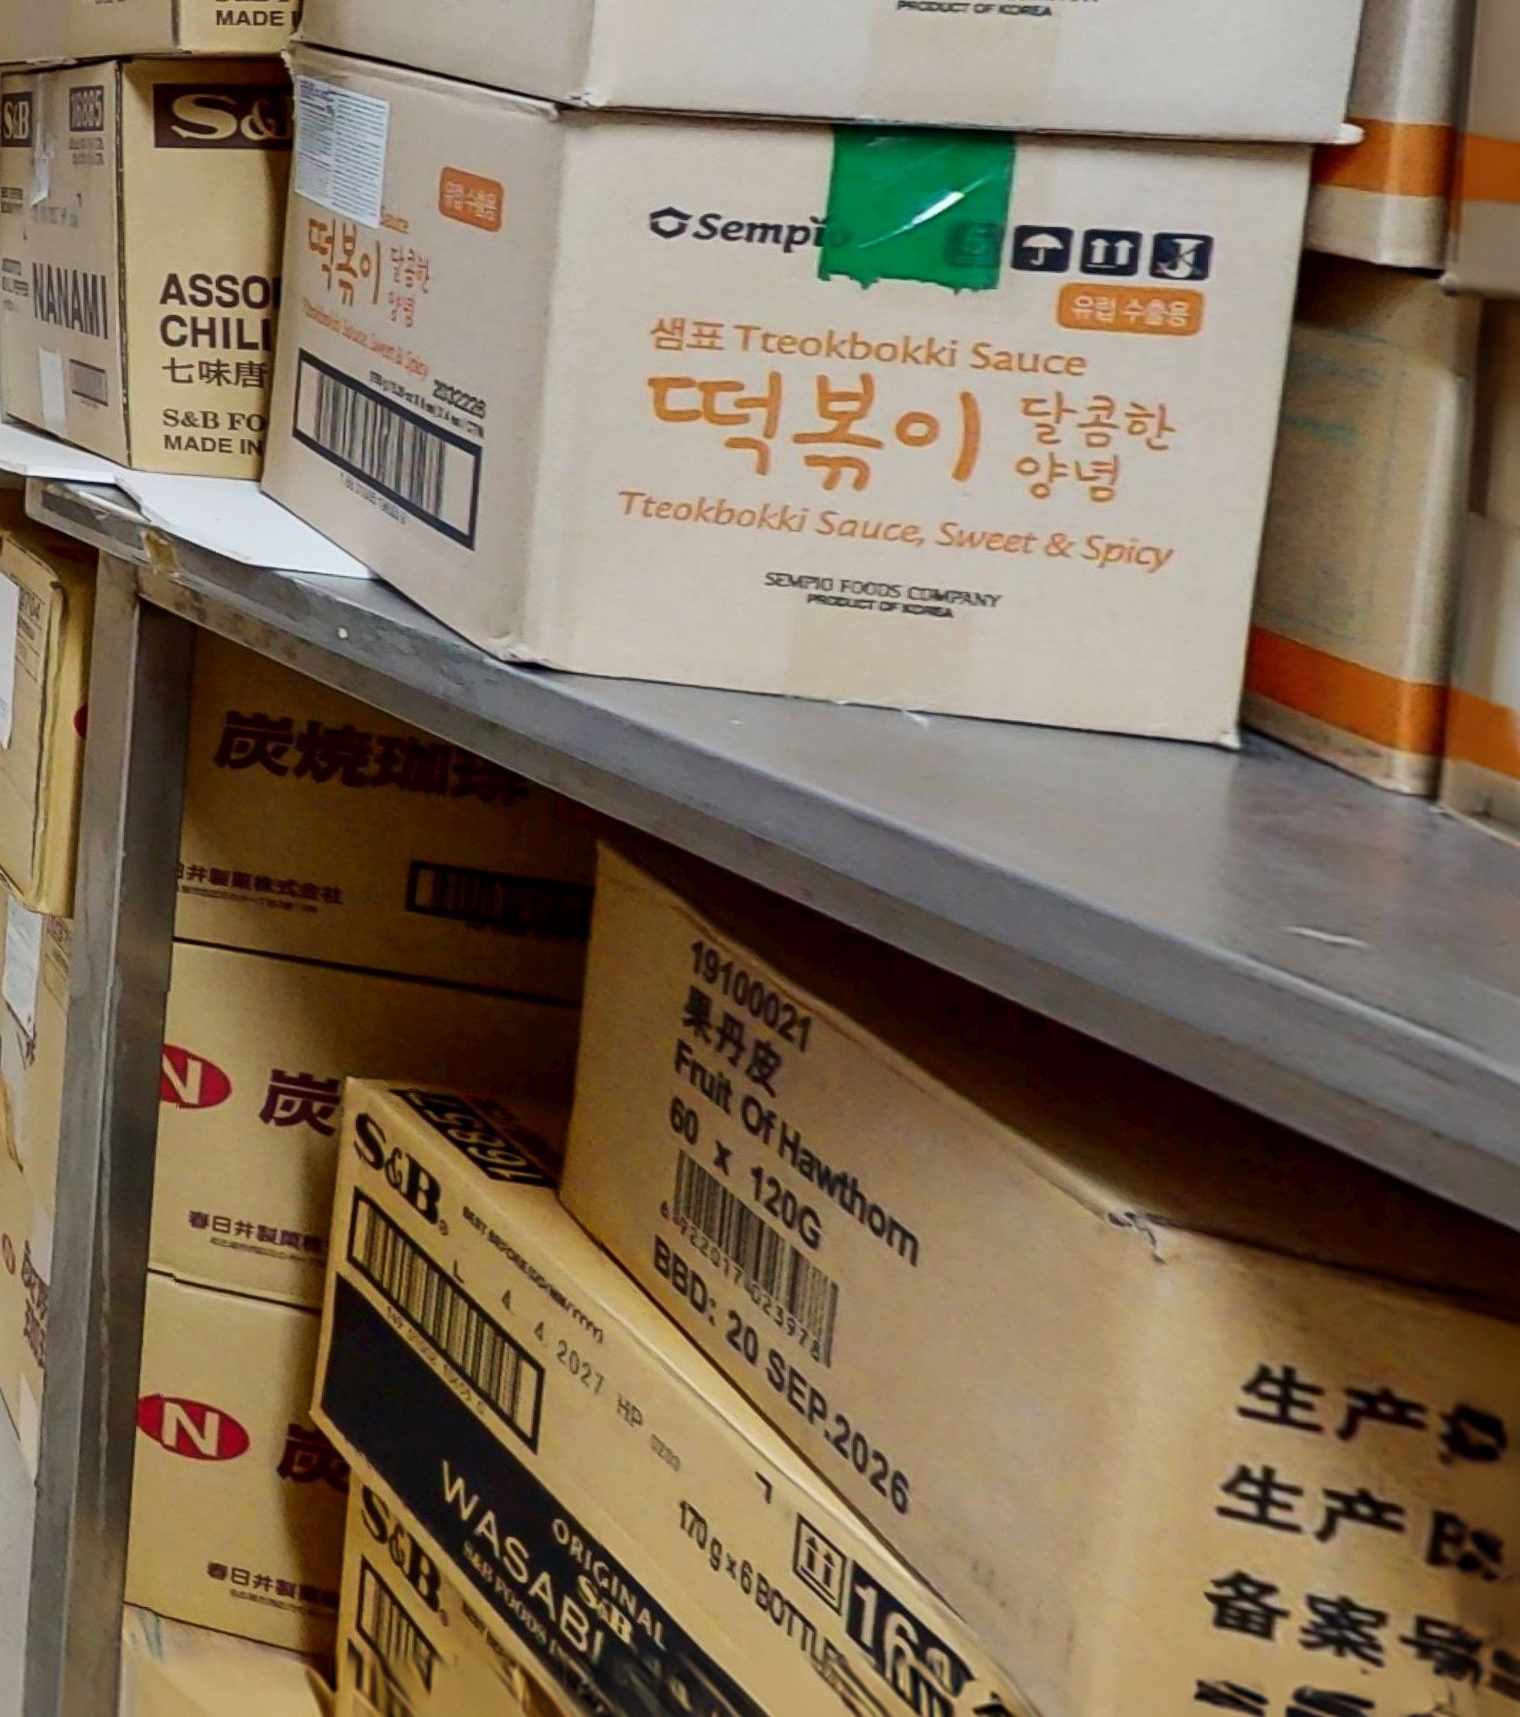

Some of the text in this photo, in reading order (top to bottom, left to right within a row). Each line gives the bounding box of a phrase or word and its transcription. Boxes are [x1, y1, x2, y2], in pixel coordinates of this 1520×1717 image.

[216, 11, 283, 27] MADE
[32, 262, 108, 339] NANAMI
[650, 317, 1088, 378] 샘표 Tteokbokki Sauce
[162, 409, 220, 430] S&B
[163, 435, 233, 454] MADE
[647, 371, 983, 492] 떡볶이
[1021, 391, 1176, 451] 달콤한
[619, 491, 1174, 574] Tteokbokki Sauce, Sweet & Spicy
[1015, 452, 1122, 504] 양념
[683, 986, 782, 1098] 果丹皮
[691, 940, 812, 1054] 19100021
[354, 1113, 441, 1225] S&B
[670, 1096, 699, 1145] 60
[751, 1166, 822, 1251] 120G
[675, 1039, 920, 1268] Fruit Of Hawthorn
[653, 1235, 718, 1320] BBD:
[726, 1310, 761, 1367] 20
[766, 1352, 911, 1517] SEP.2026
[361, 1485, 442, 1613] S&B
[443, 1460, 605, 1665] WASABI
[552, 1518, 667, 1651] ORIGINAL
